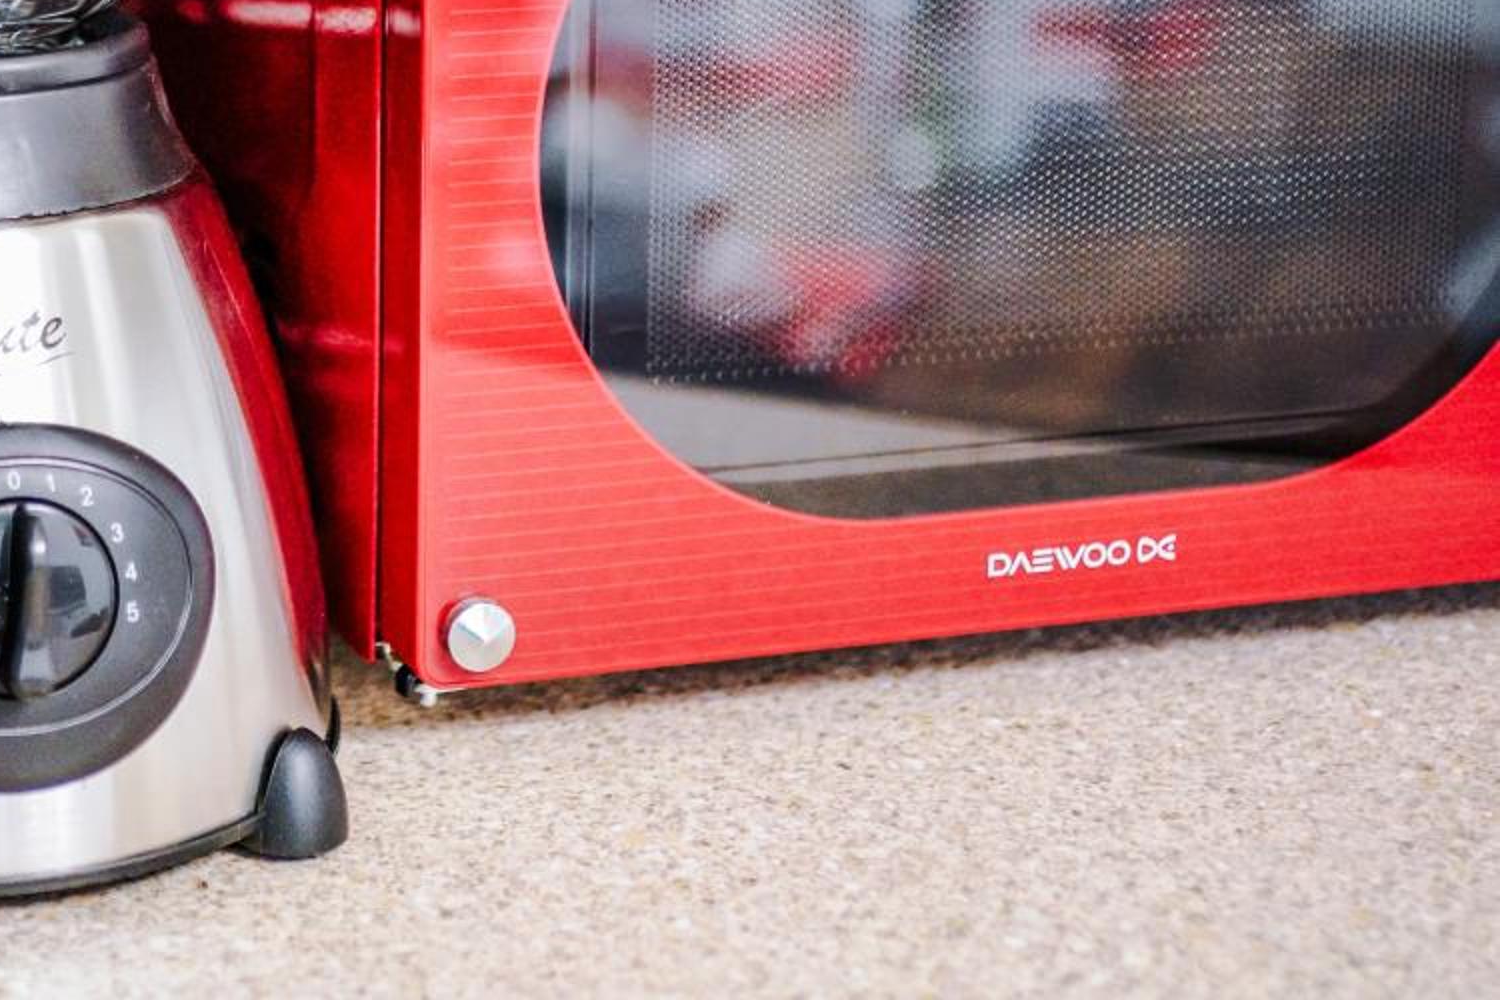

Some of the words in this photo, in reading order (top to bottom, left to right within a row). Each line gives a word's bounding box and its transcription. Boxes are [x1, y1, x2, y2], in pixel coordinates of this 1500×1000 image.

[46, 472, 57, 493] 1
[80, 486, 95, 507] 2
[110, 522, 124, 543] 3
[987, 540, 1131, 577] DAEWOO
[124, 562, 138, 582] 4
[126, 602, 140, 623] 5
